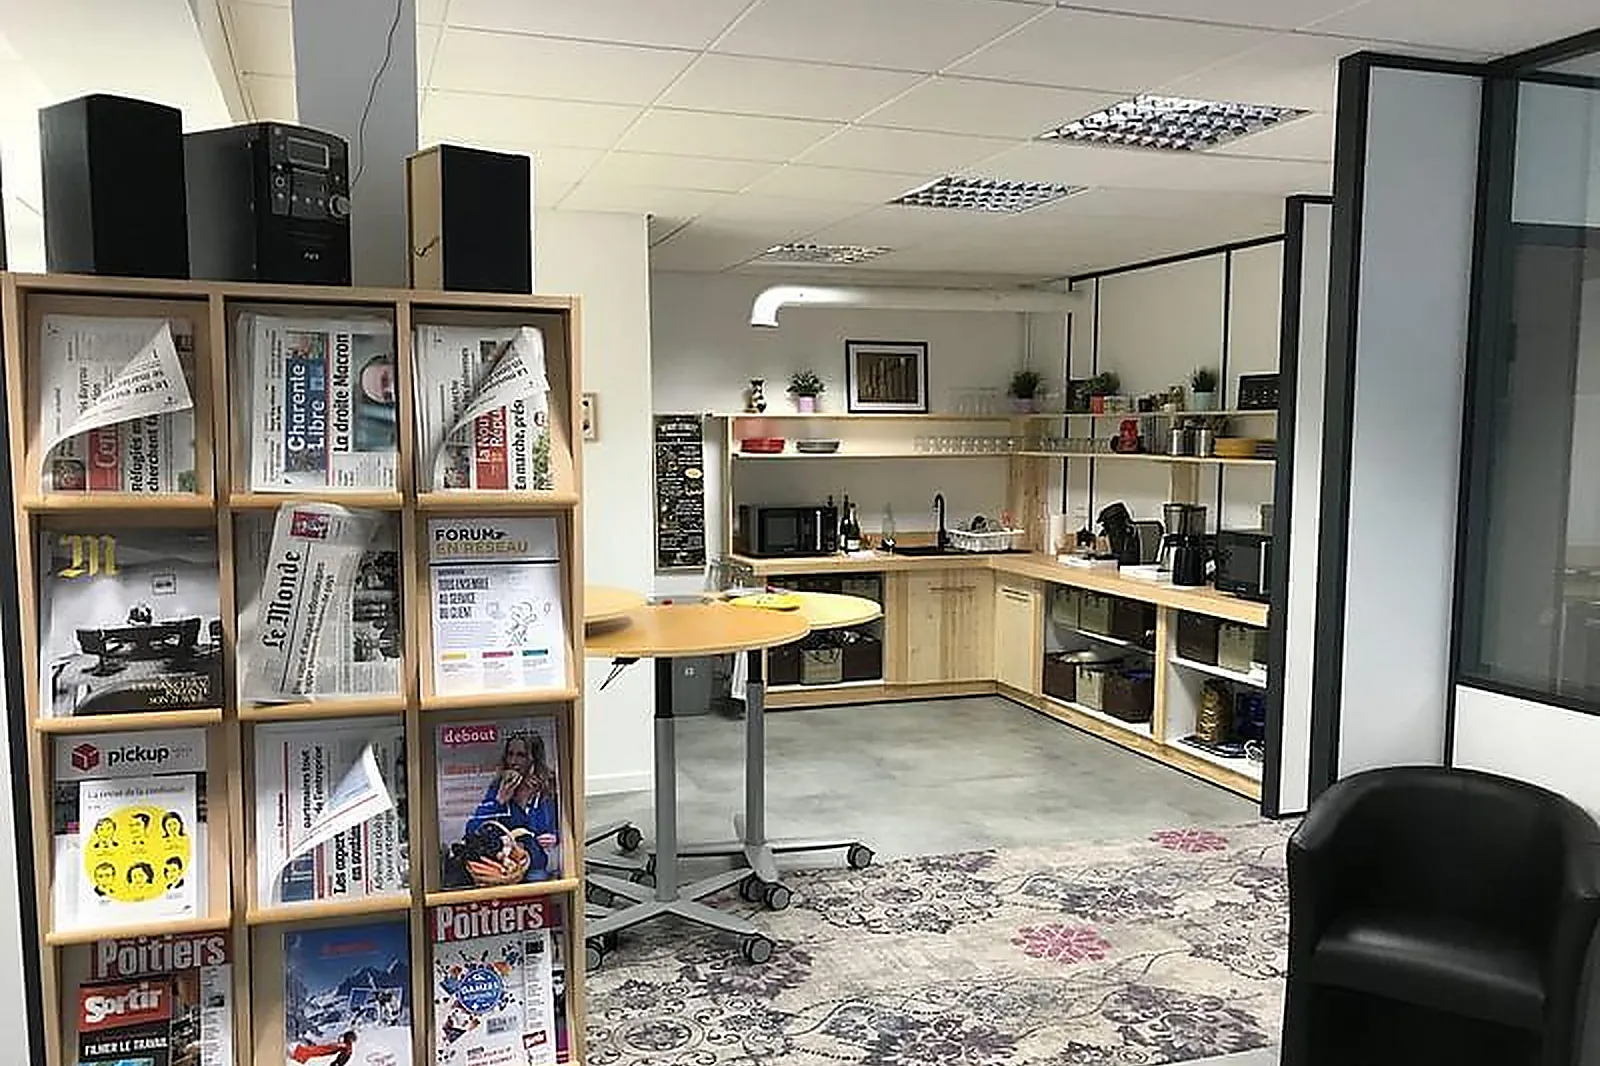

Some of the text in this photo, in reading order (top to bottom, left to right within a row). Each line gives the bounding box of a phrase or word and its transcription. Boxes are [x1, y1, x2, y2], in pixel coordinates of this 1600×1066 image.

[287, 364, 306, 451] Charente
[333, 333, 349, 452] La droite Macron
[307, 399, 325, 450] Libre
[515, 477, 526, 490] En
[435, 528, 495, 541] FORUM
[262, 551, 301, 653] Le Monde
[108, 746, 169, 766] pickup
[444, 729, 496, 743] debout
[334, 870, 347, 894] Les
[436, 901, 543, 942] Poitiers
[97, 934, 225, 979] Poitiers
[84, 981, 163, 1023] Sortir
